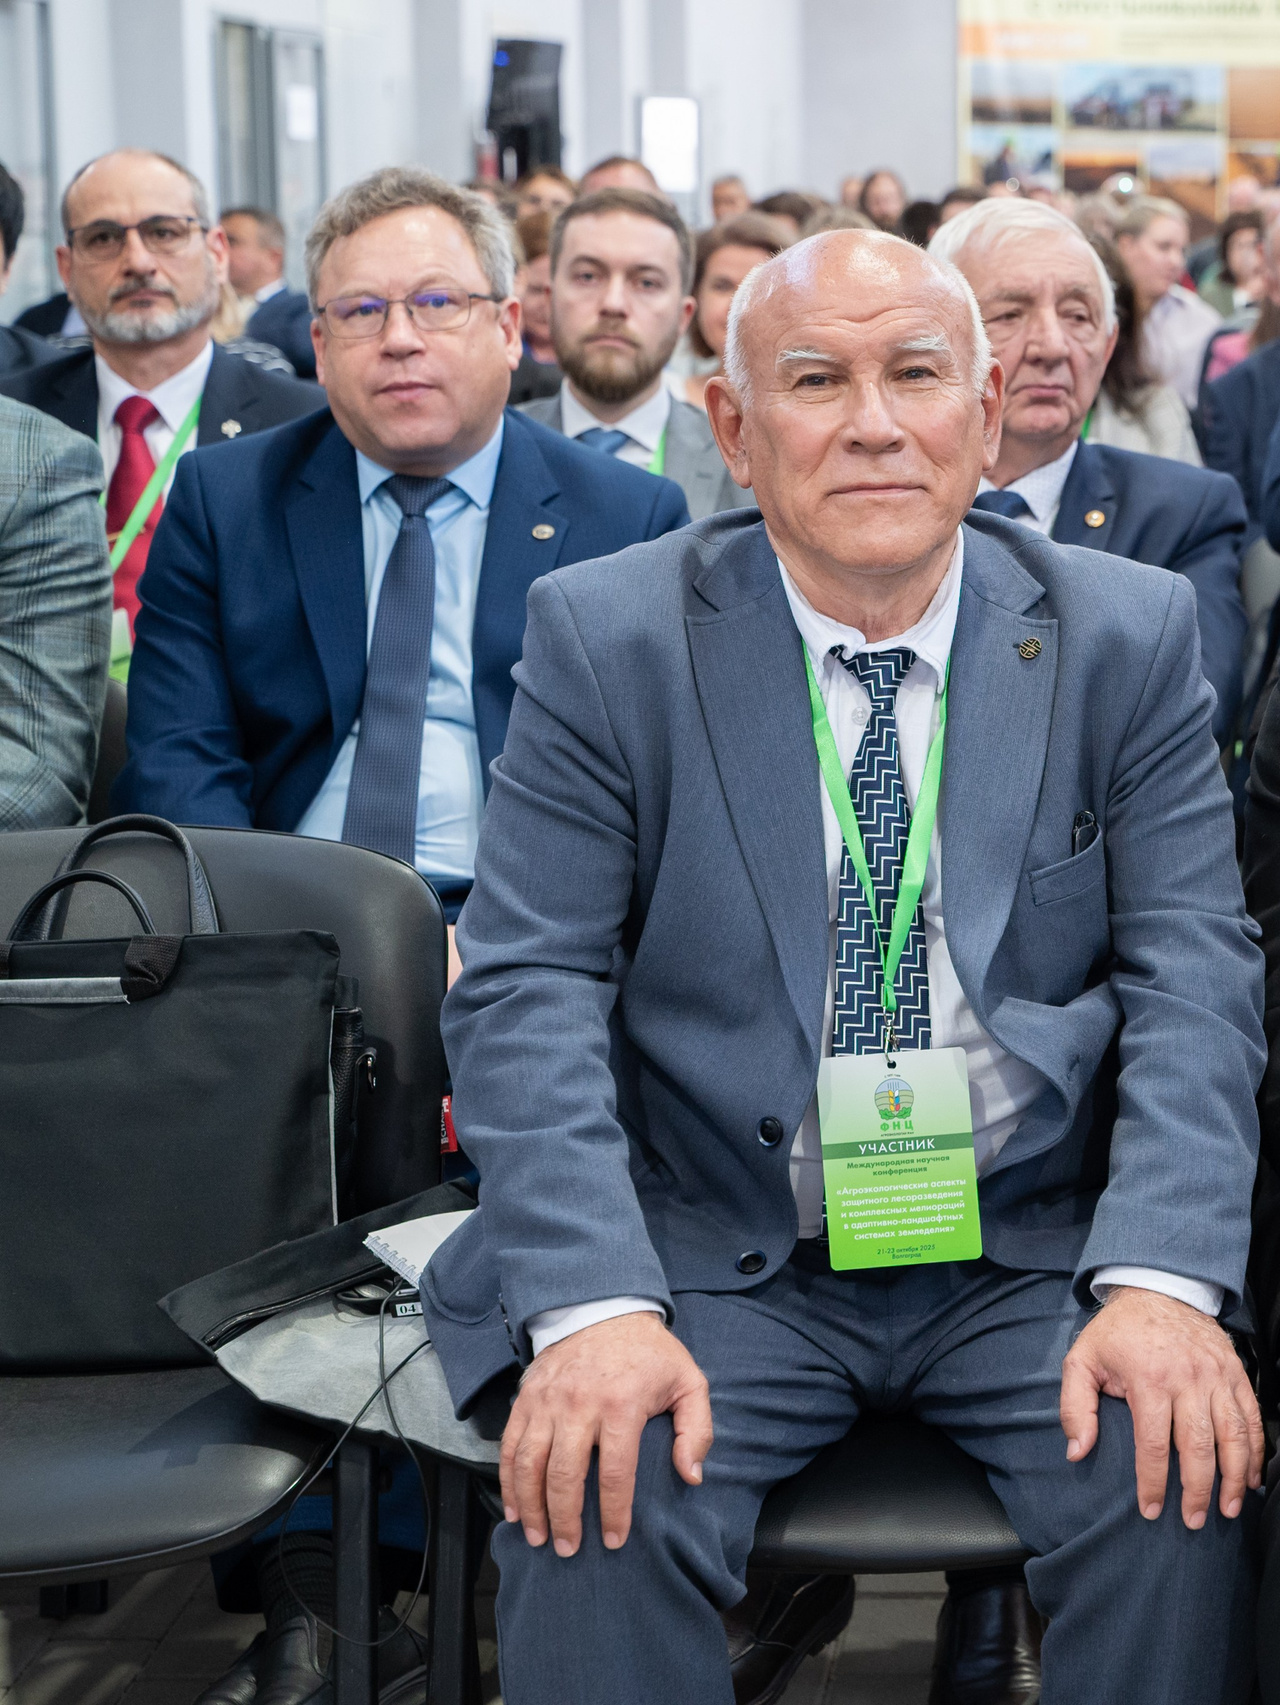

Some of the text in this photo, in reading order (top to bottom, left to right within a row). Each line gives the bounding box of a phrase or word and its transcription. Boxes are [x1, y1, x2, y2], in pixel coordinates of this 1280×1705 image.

[858, 1138, 935, 1155] УЧАСТНИК
[847, 1156, 950, 1169] Международная научная
[872, 1167, 928, 1176] конференция
[836, 1179, 966, 1196] «Агроэкологические аспекты
[841, 1191, 963, 1207] защитного лесоразведения
[848, 1207, 908, 1218] комплексных
[909, 1200, 965, 1212] мелиораций
[851, 1213, 964, 1230] адаптивно-ландшафтных
[854, 1226, 955, 1240] системах земледелия»
[400, 1304, 416, 1314] 04
